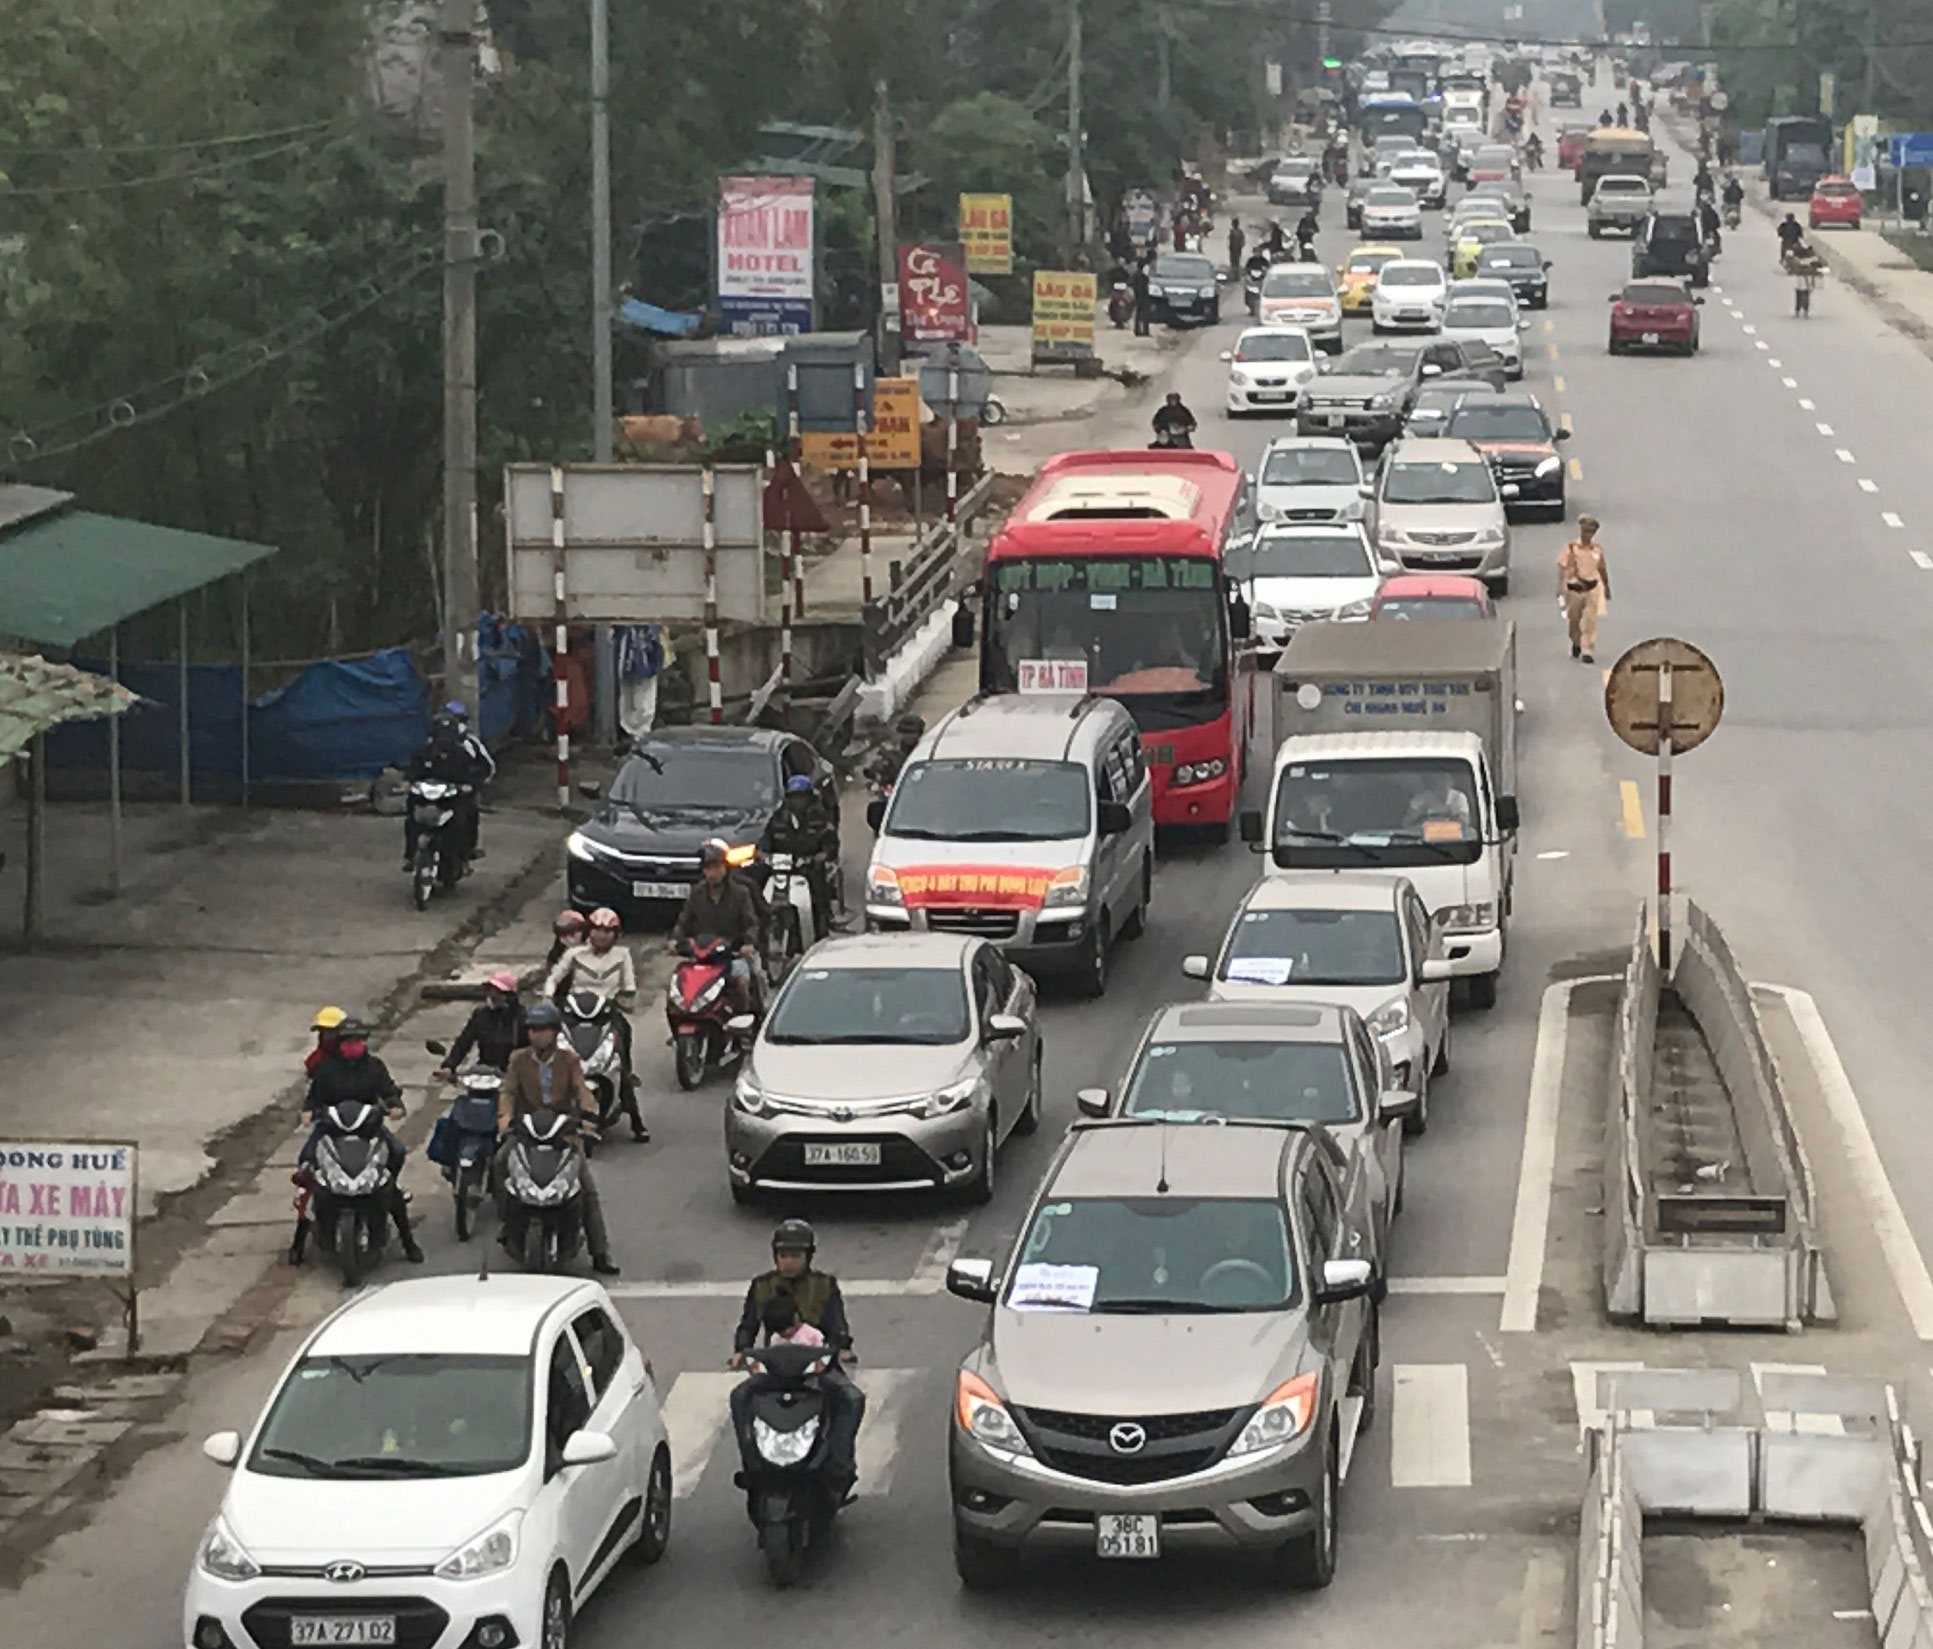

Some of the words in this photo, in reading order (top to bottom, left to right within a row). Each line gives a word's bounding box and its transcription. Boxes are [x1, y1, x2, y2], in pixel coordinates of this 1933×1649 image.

[1021, 666, 1036, 688] TP
[29, 1183, 60, 1216] XE
[70, 1180, 125, 1217] MÁY
